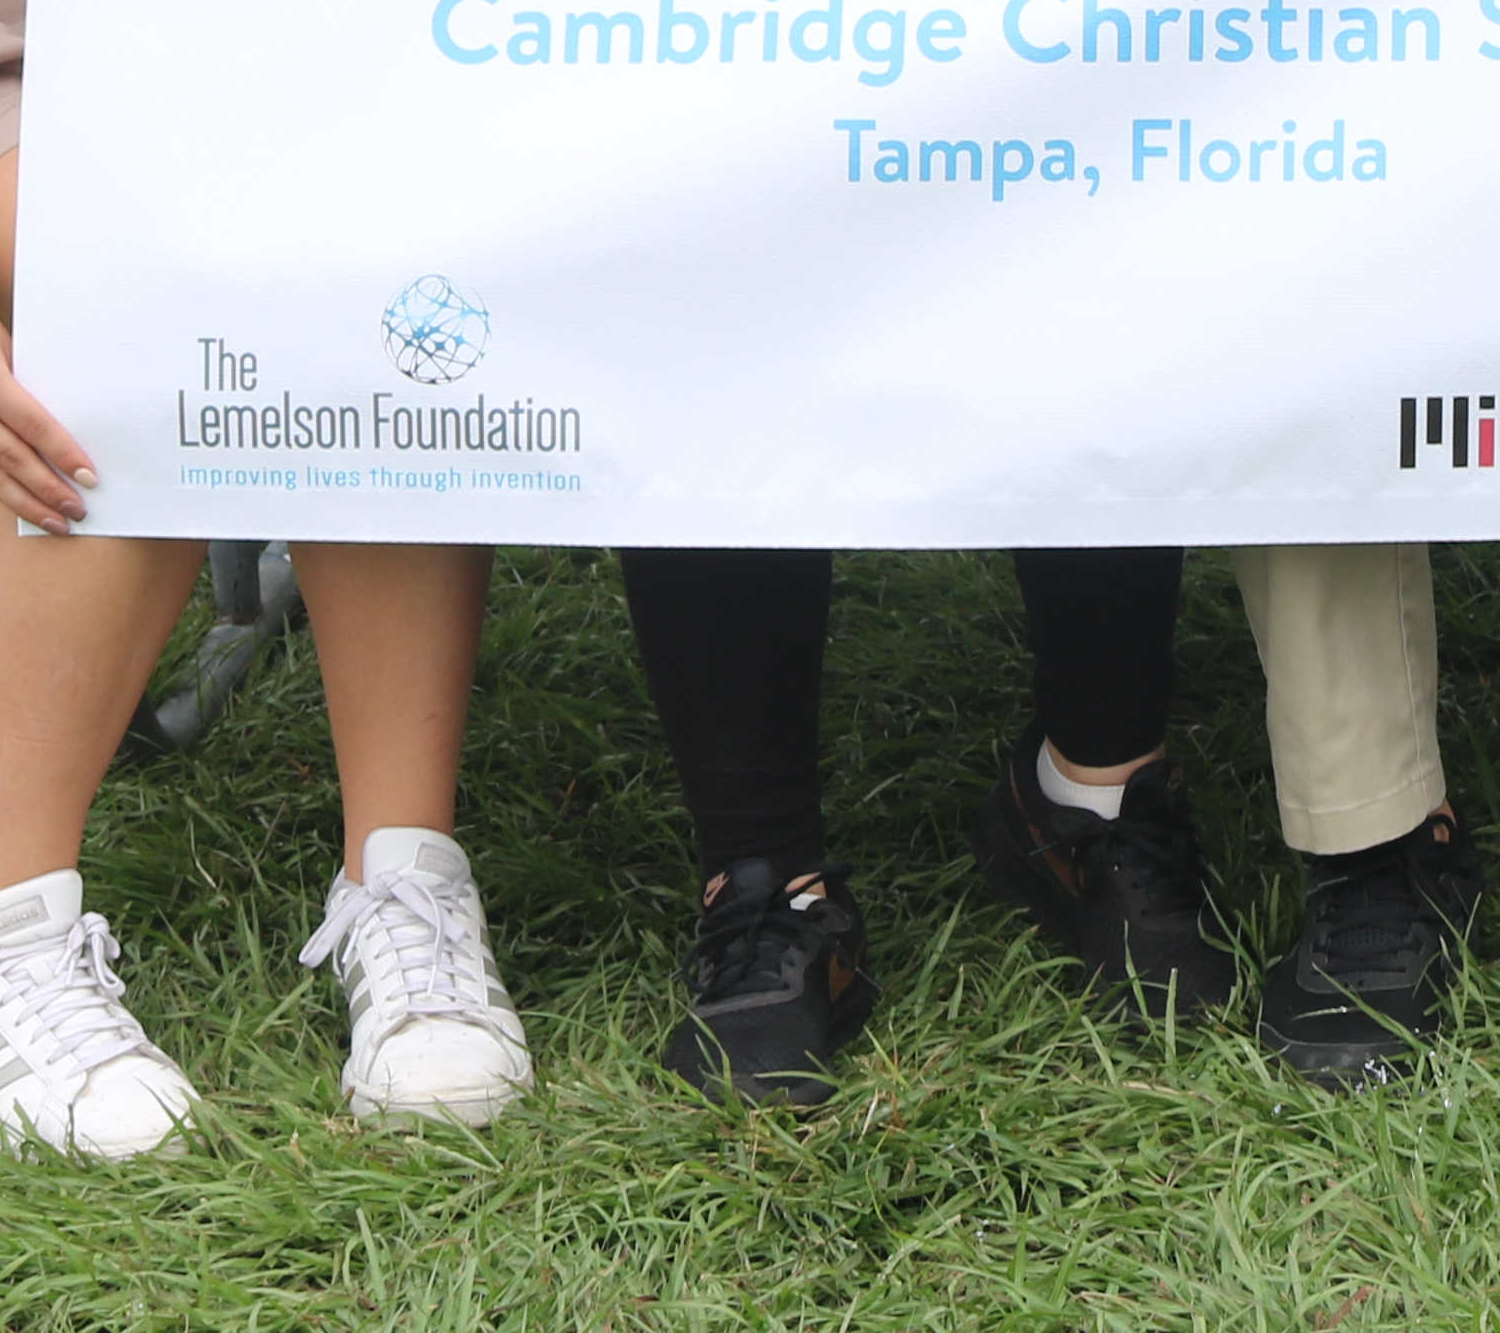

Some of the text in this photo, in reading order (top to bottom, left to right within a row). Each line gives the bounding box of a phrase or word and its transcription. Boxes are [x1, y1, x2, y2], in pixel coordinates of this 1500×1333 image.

[833, 119, 1388, 202] Tampa, Florida
[197, 337, 258, 392] The
[178, 389, 582, 452] Lemelson Foundation
[180, 464, 582, 492] improving lives through invention
